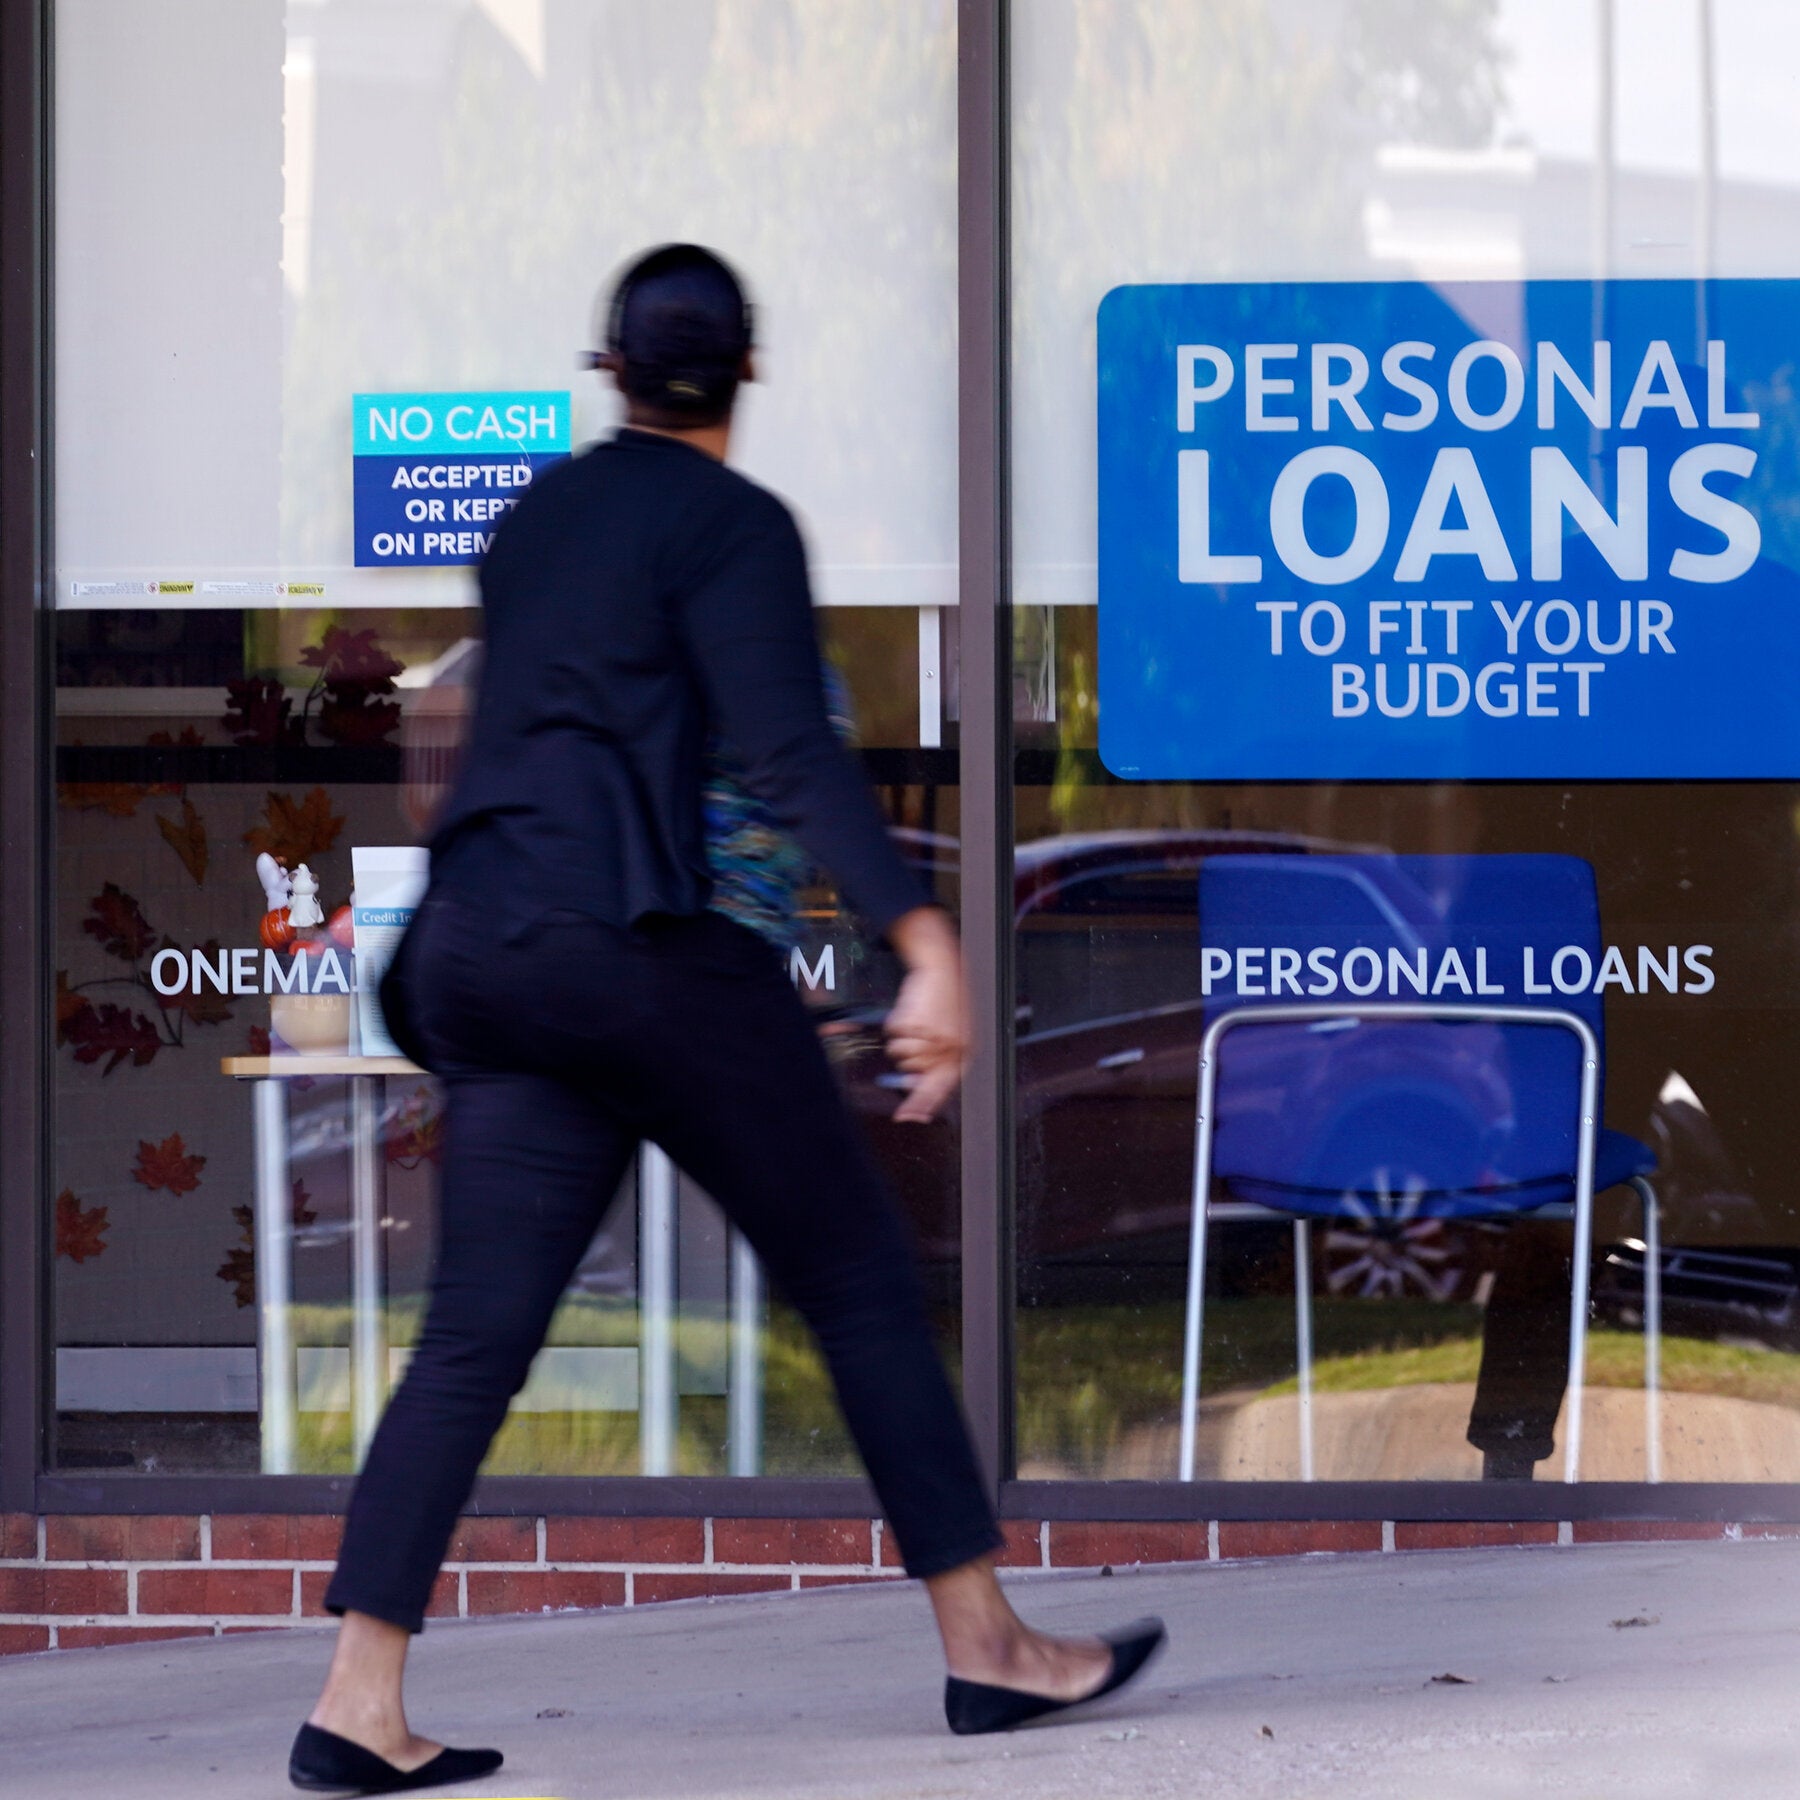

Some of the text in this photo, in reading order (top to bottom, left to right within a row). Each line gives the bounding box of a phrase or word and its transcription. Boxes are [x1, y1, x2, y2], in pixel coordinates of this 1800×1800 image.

[1176, 339, 1761, 433] PERSONAL
[369, 405, 556, 441] NO CASH
[391, 464, 533, 489] ACCEPTED
[405, 498, 446, 522] OR
[1177, 442, 1762, 585] LOANS
[372, 532, 497, 556] ON PREM
[1255, 599, 1676, 656] TO FIT YOUR
[1332, 662, 1606, 718] BUDGET
[362, 911, 413, 924] Credit In
[1201, 945, 1715, 995] PERSONAL LOANS
